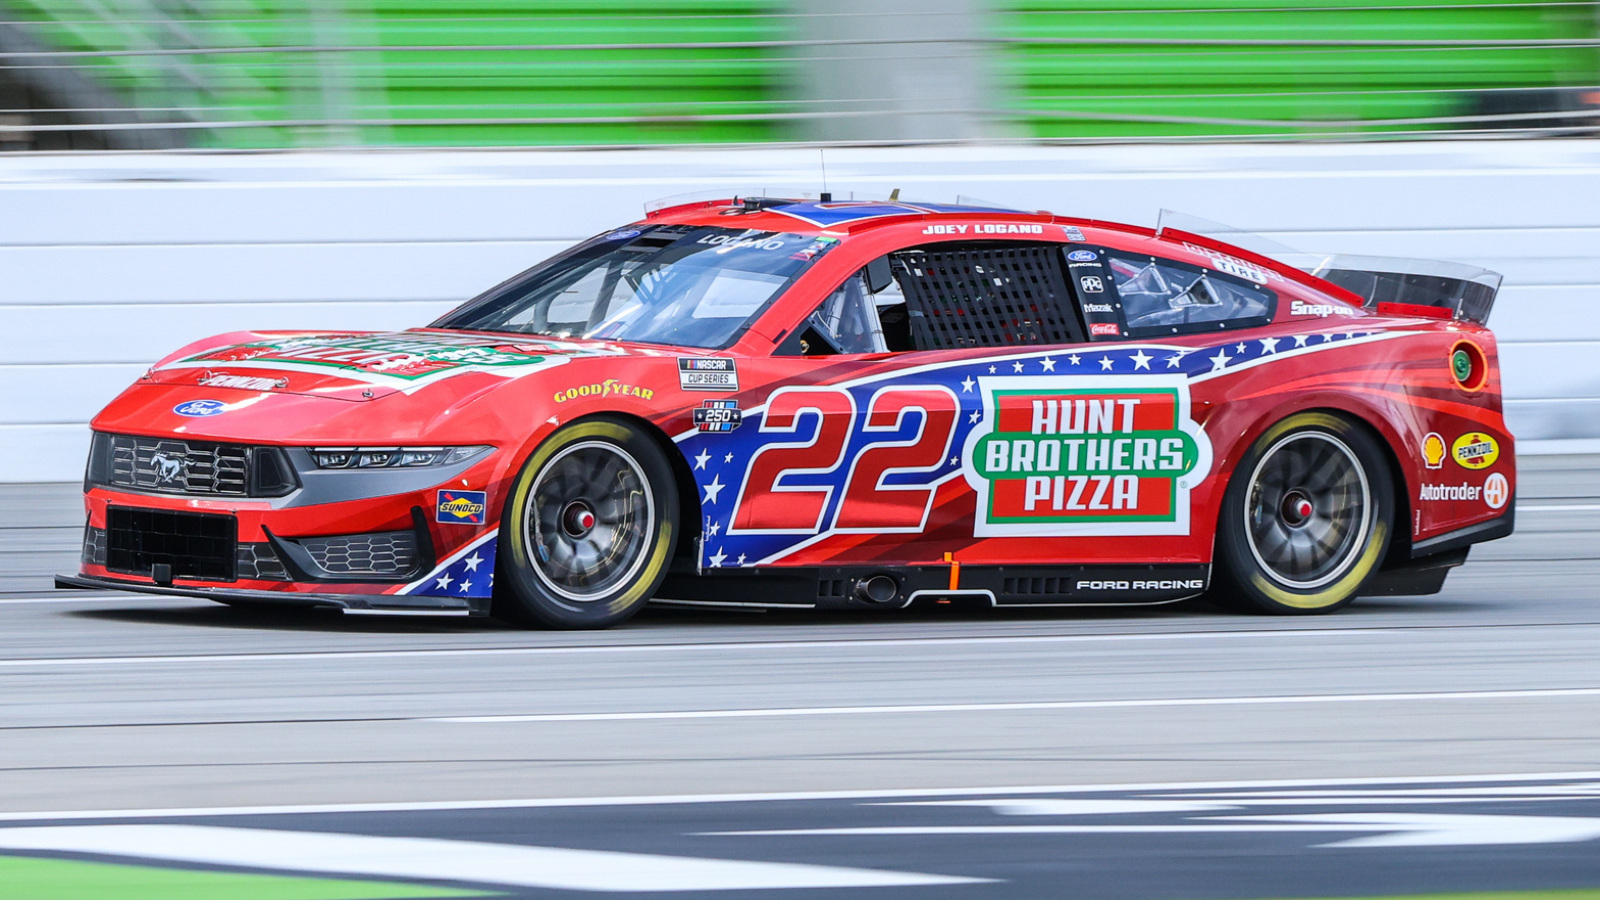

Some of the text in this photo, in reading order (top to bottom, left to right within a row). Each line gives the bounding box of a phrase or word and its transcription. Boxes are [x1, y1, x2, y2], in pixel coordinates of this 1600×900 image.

[922, 224, 1043, 235] JOEY LOGANO
[1217, 260, 1261, 281] TIRE
[1082, 278, 1102, 291] PPG
[1083, 303, 1114, 313] Mazak
[1291, 300, 1354, 317] Snap-on
[696, 360, 727, 370] NASCAR
[688, 373, 729, 384] CUP SERIES
[705, 409, 731, 422] 250
[1030, 398, 1141, 435] HUNT
[984, 437, 1184, 472] BROTHERS
[1457, 441, 1494, 459] PENNZOIL
[725, 384, 962, 536] 22
[1023, 474, 1139, 511] PIZZA
[1419, 481, 1482, 500] Autotrader
[441, 503, 482, 513] SUNOCO
[1076, 580, 1203, 590] FORD RACING
